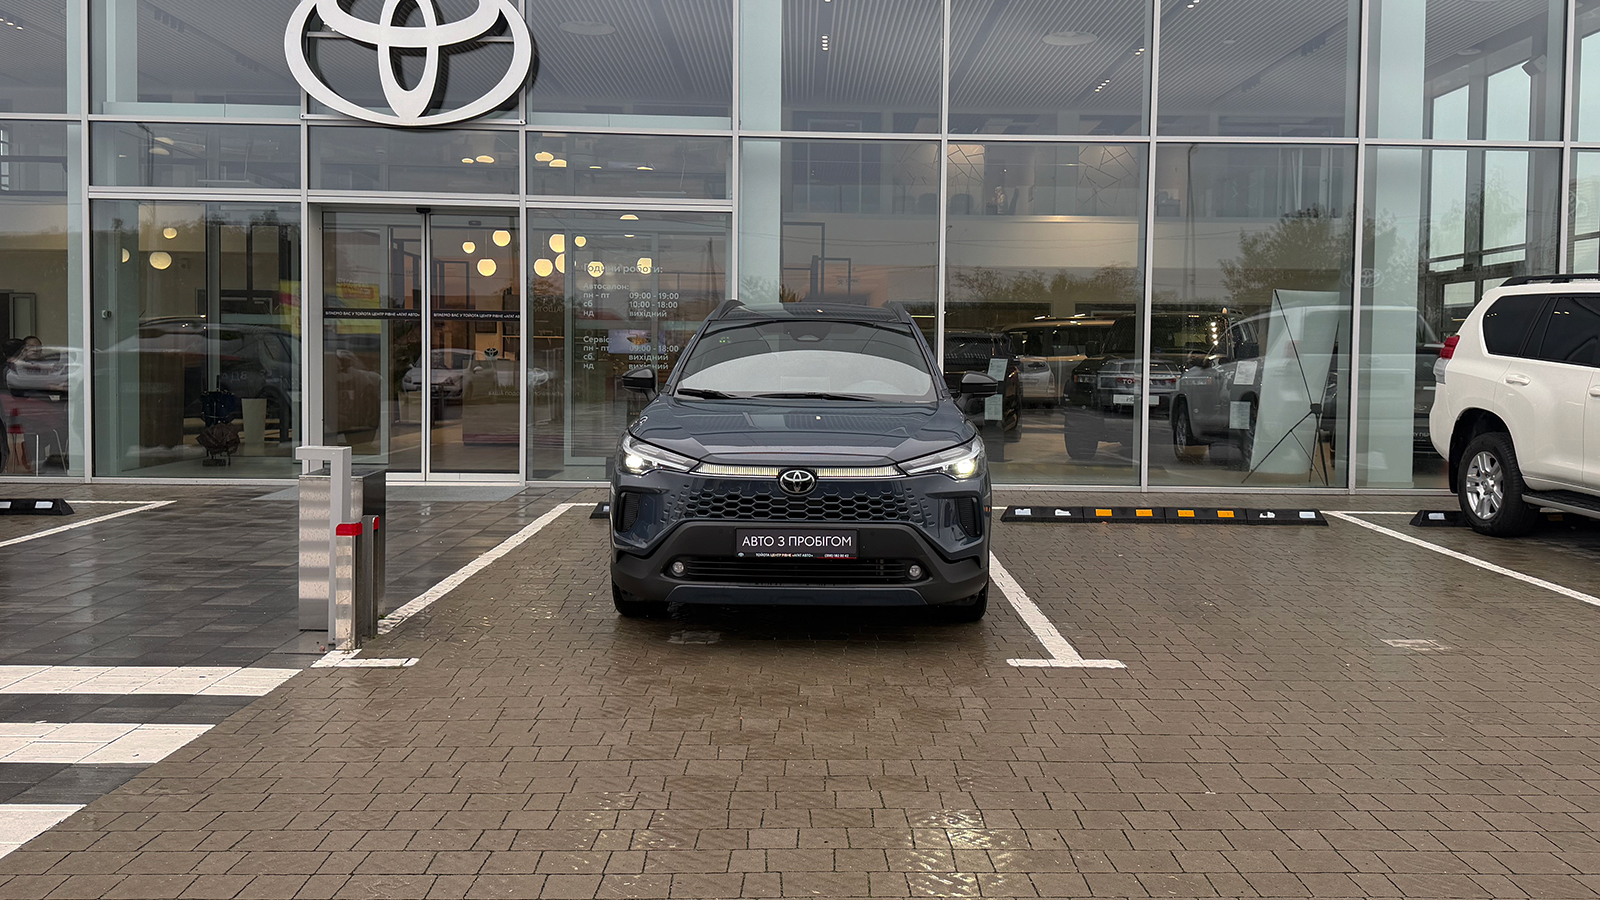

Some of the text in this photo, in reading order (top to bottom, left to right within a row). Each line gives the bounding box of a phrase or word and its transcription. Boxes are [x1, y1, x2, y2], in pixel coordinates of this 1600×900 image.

[584, 263, 663, 274] Години роботи:
[629, 310, 667, 318] вихідний
[628, 353, 668, 361] вихідний
[742, 536, 852, 547] АВТО З ПРОБІГОМ
